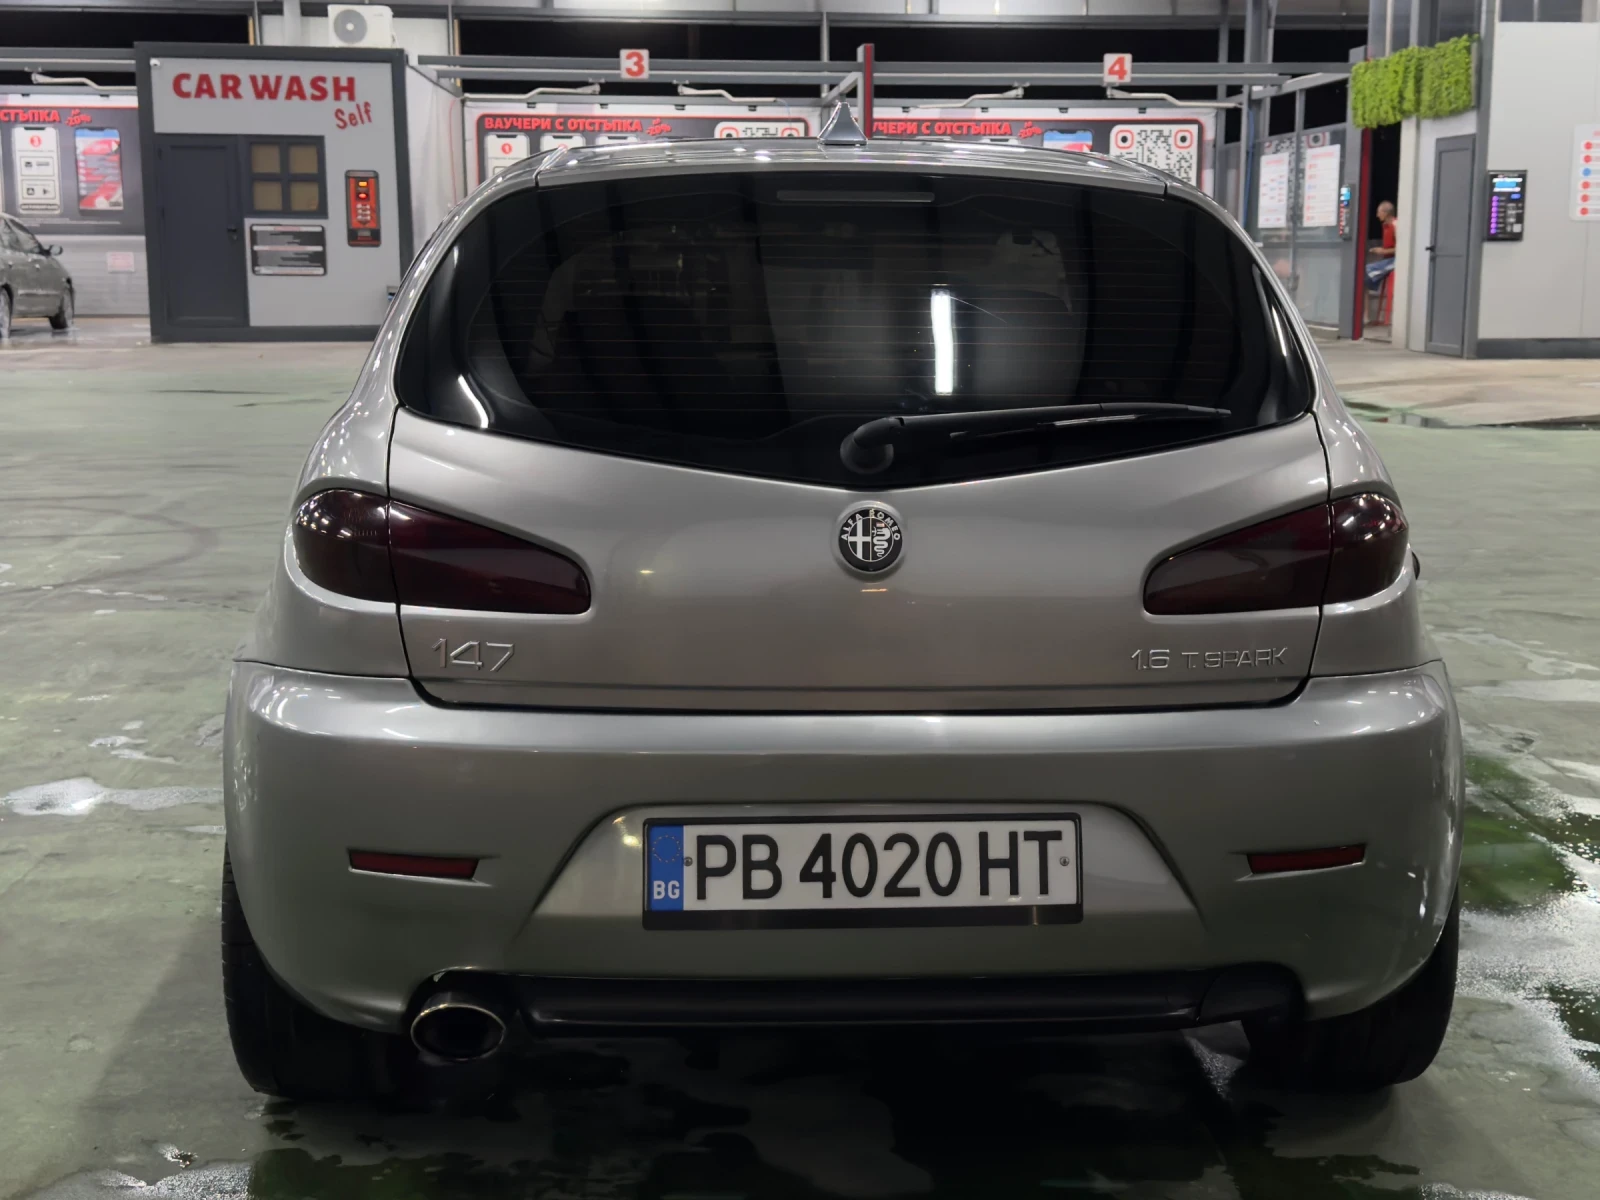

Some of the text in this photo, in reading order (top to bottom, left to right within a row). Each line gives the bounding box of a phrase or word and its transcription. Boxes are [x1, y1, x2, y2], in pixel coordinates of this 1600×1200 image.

[625, 51, 645, 77] 3
[1108, 56, 1128, 81] 4
[172, 73, 356, 102] CAR WASH
[334, 101, 372, 130] Self
[484, 117, 551, 131] ВАУЧЕРИ
[555, 118, 565, 131] С
[568, 118, 643, 133] ОТСТЪПКА
[921, 122, 931, 135] С
[934, 122, 1012, 136] ОТСТЪПКА
[841, 508, 901, 541] ALFA ROMEO
[431, 638, 515, 672] 147
[1131, 647, 1288, 670] 1.6 T. SPARK
[696, 830, 1063, 901] PB 4020 HT
[653, 880, 680, 900] BG
